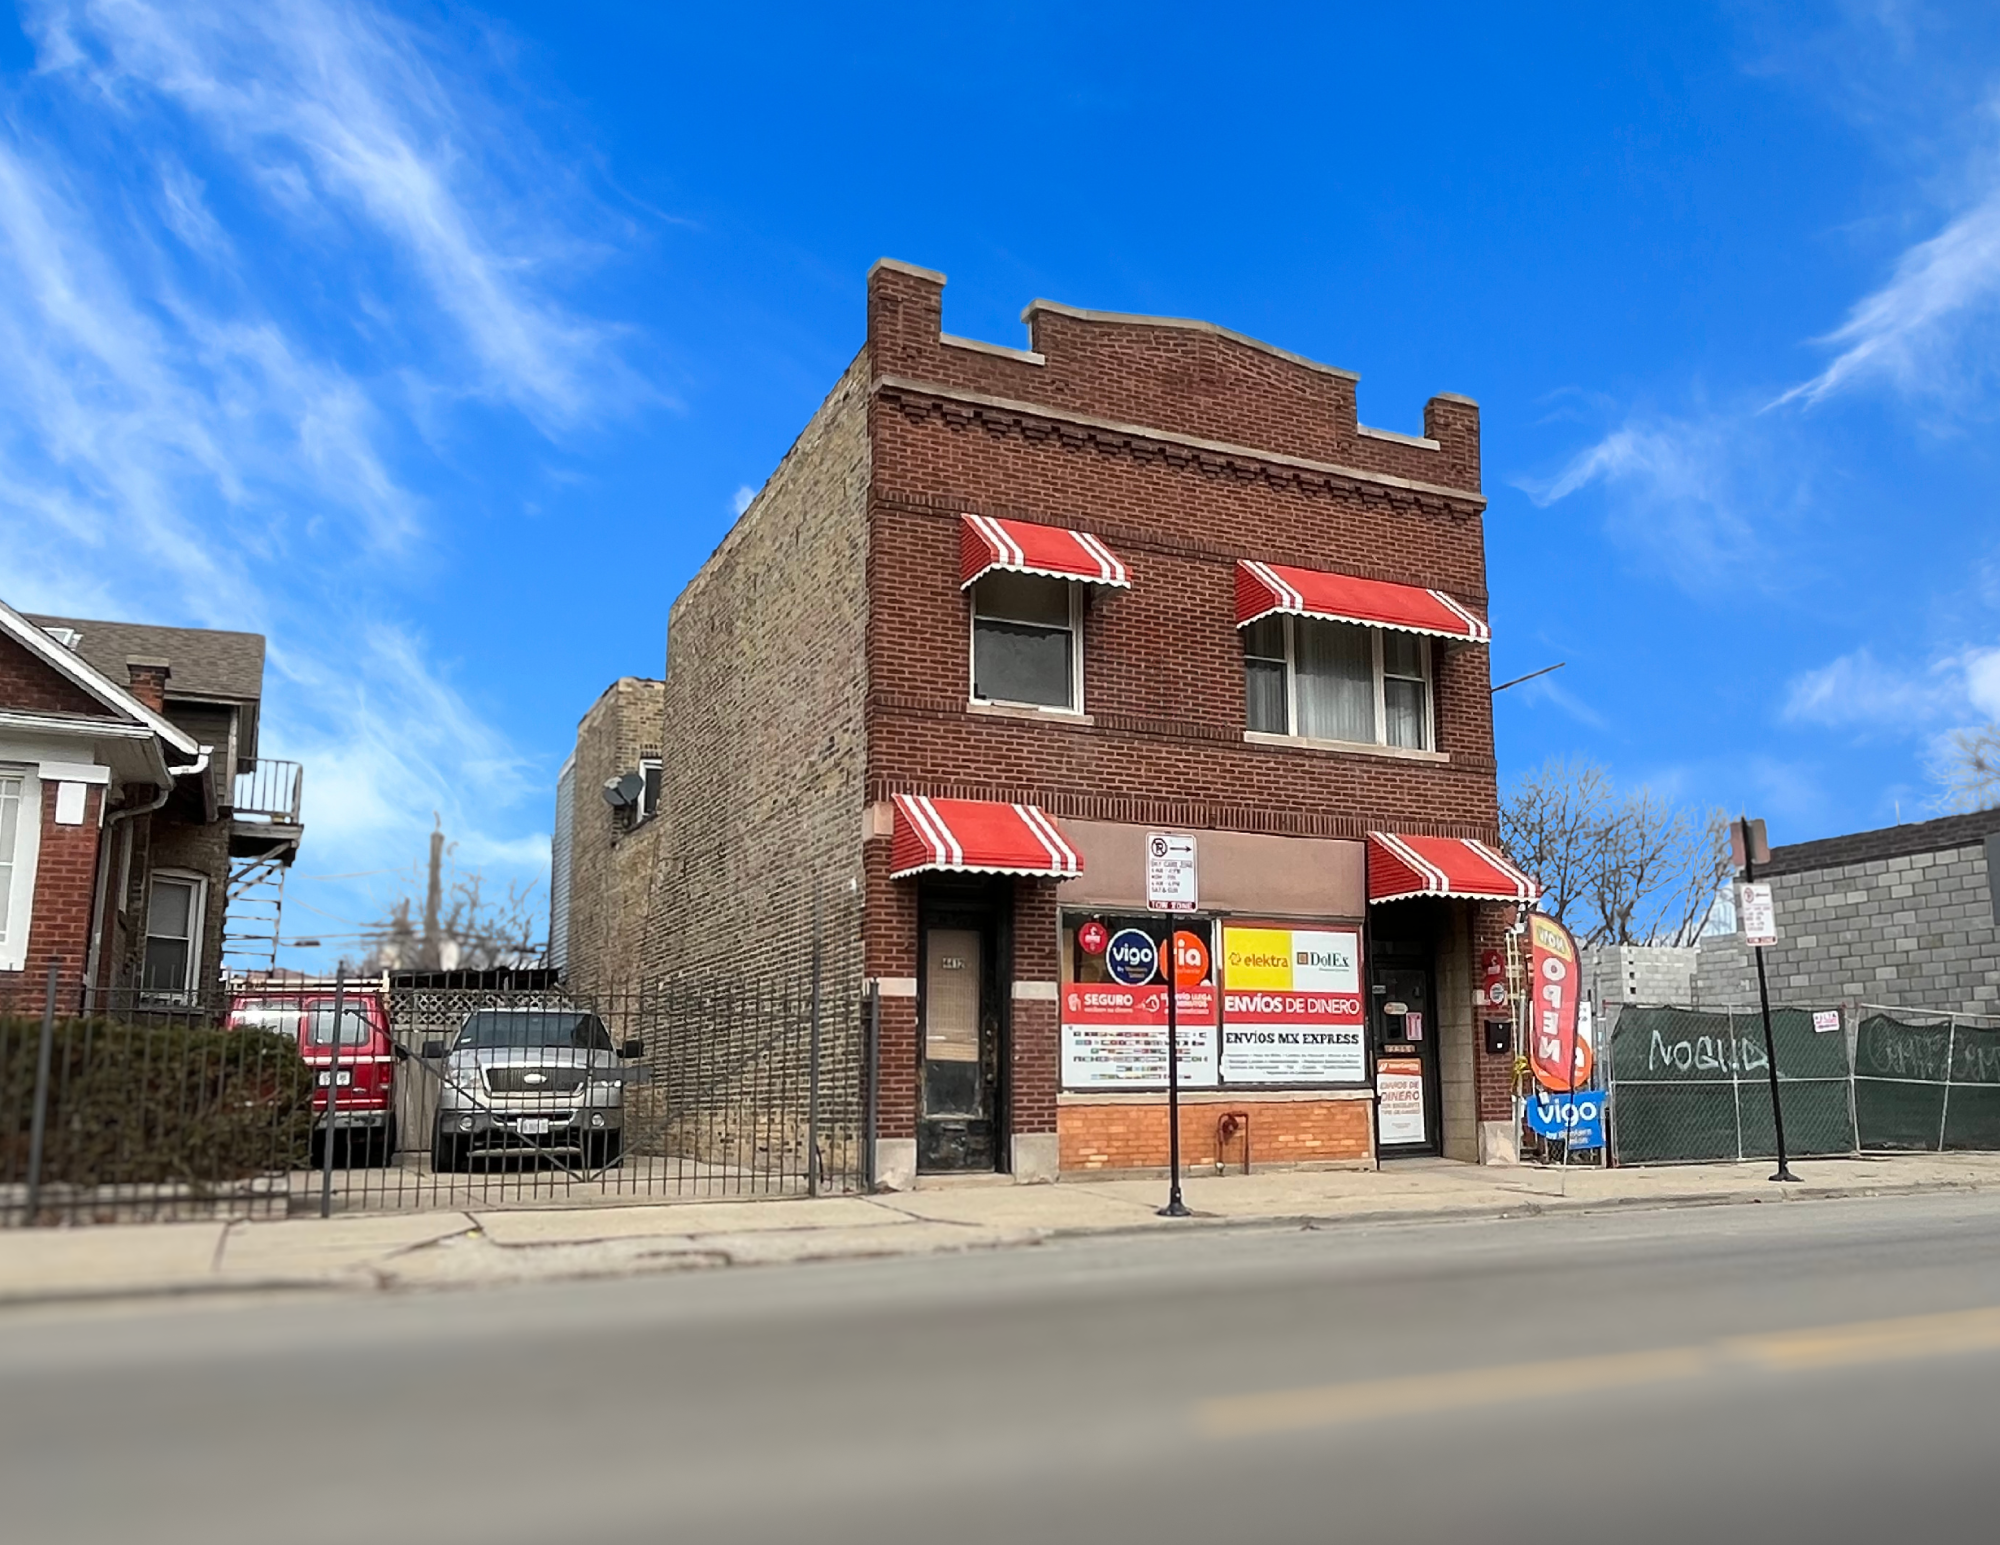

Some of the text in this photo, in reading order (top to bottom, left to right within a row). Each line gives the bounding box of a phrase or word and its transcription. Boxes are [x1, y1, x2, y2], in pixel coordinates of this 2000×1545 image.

[1151, 901, 1168, 909] TOW
[1112, 943, 1153, 966] vigo
[1244, 953, 1289, 968] elektra
[1310, 952, 1350, 968] DolEx
[1083, 993, 1134, 1007] SEGURO
[1224, 993, 1360, 1015] ENVÍOS DE DINERO
[1278, 1032, 1300, 1044] MX
[1302, 1033, 1360, 1045] EXPRESS
[1380, 1090, 1420, 1102] DINERO
[1537, 1098, 1598, 1127] vigo
